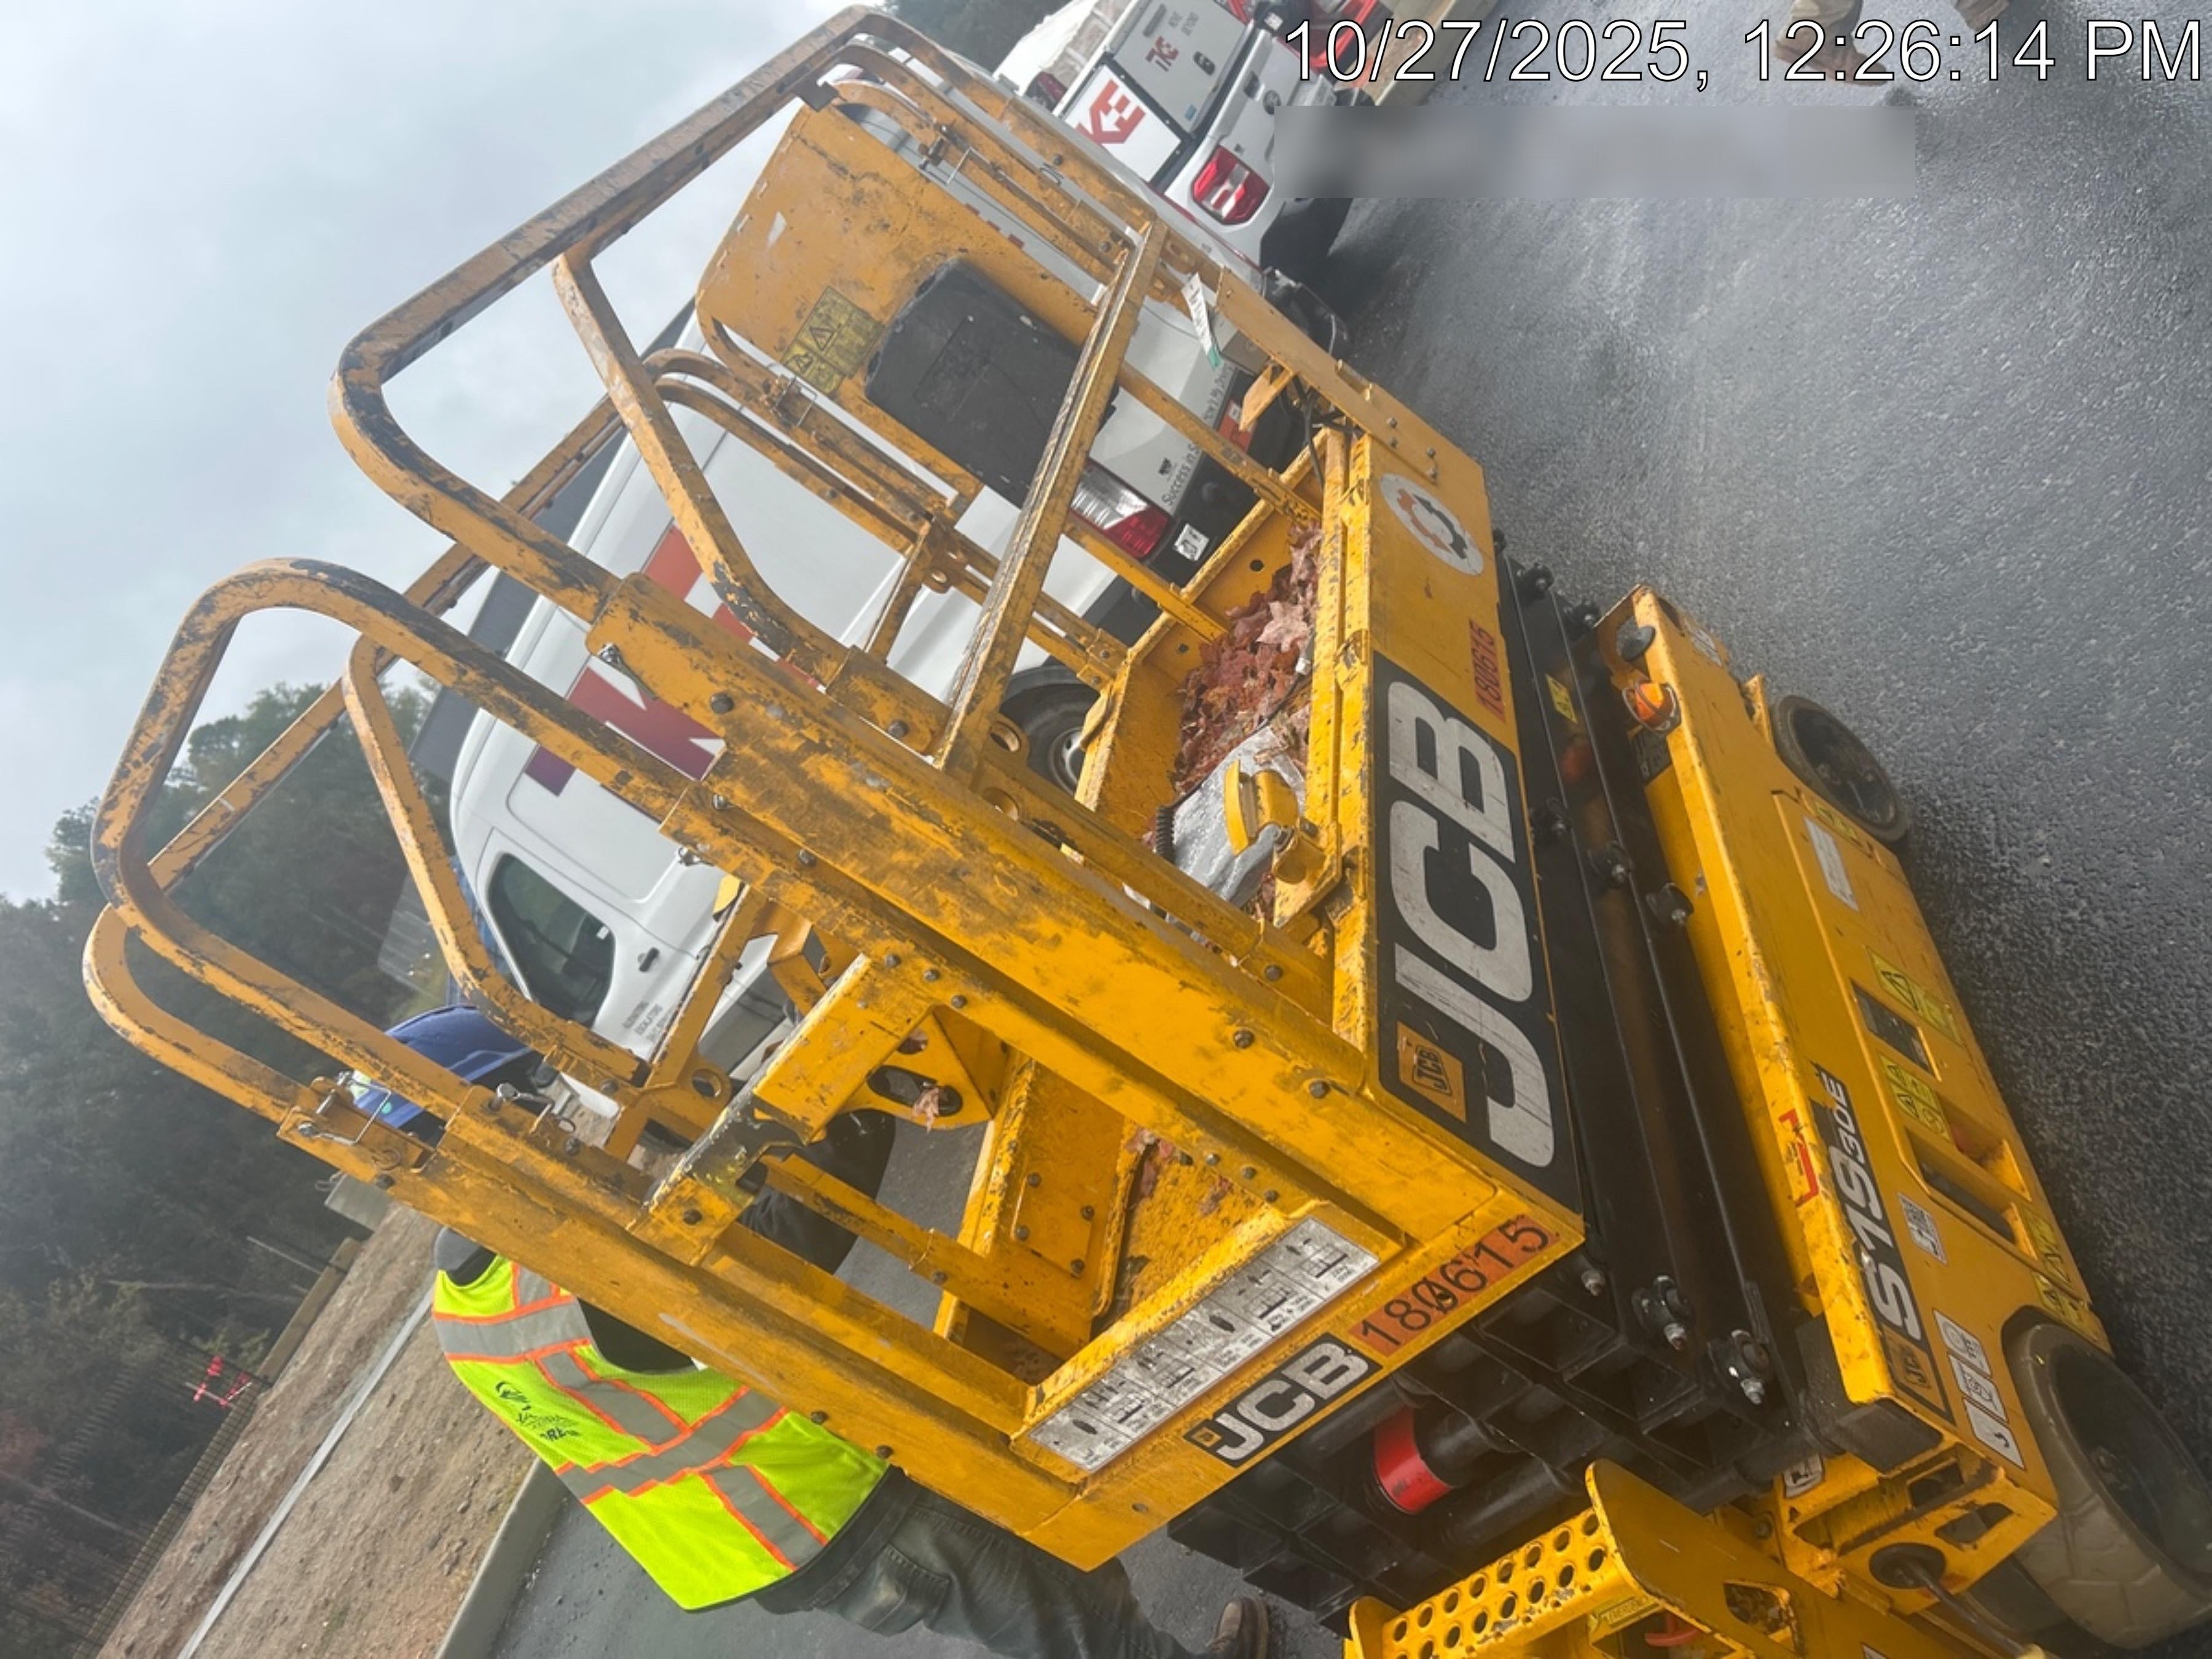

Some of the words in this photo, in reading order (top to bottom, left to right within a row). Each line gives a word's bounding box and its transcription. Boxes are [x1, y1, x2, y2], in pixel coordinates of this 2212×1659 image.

[1469, 618, 1504, 715] 180615
[1387, 681, 1556, 1167] JCB
[1416, 1047, 1448, 1091] JCB
[1362, 1215, 1550, 1347] 180615
[1215, 1341, 1370, 1462] JCB
